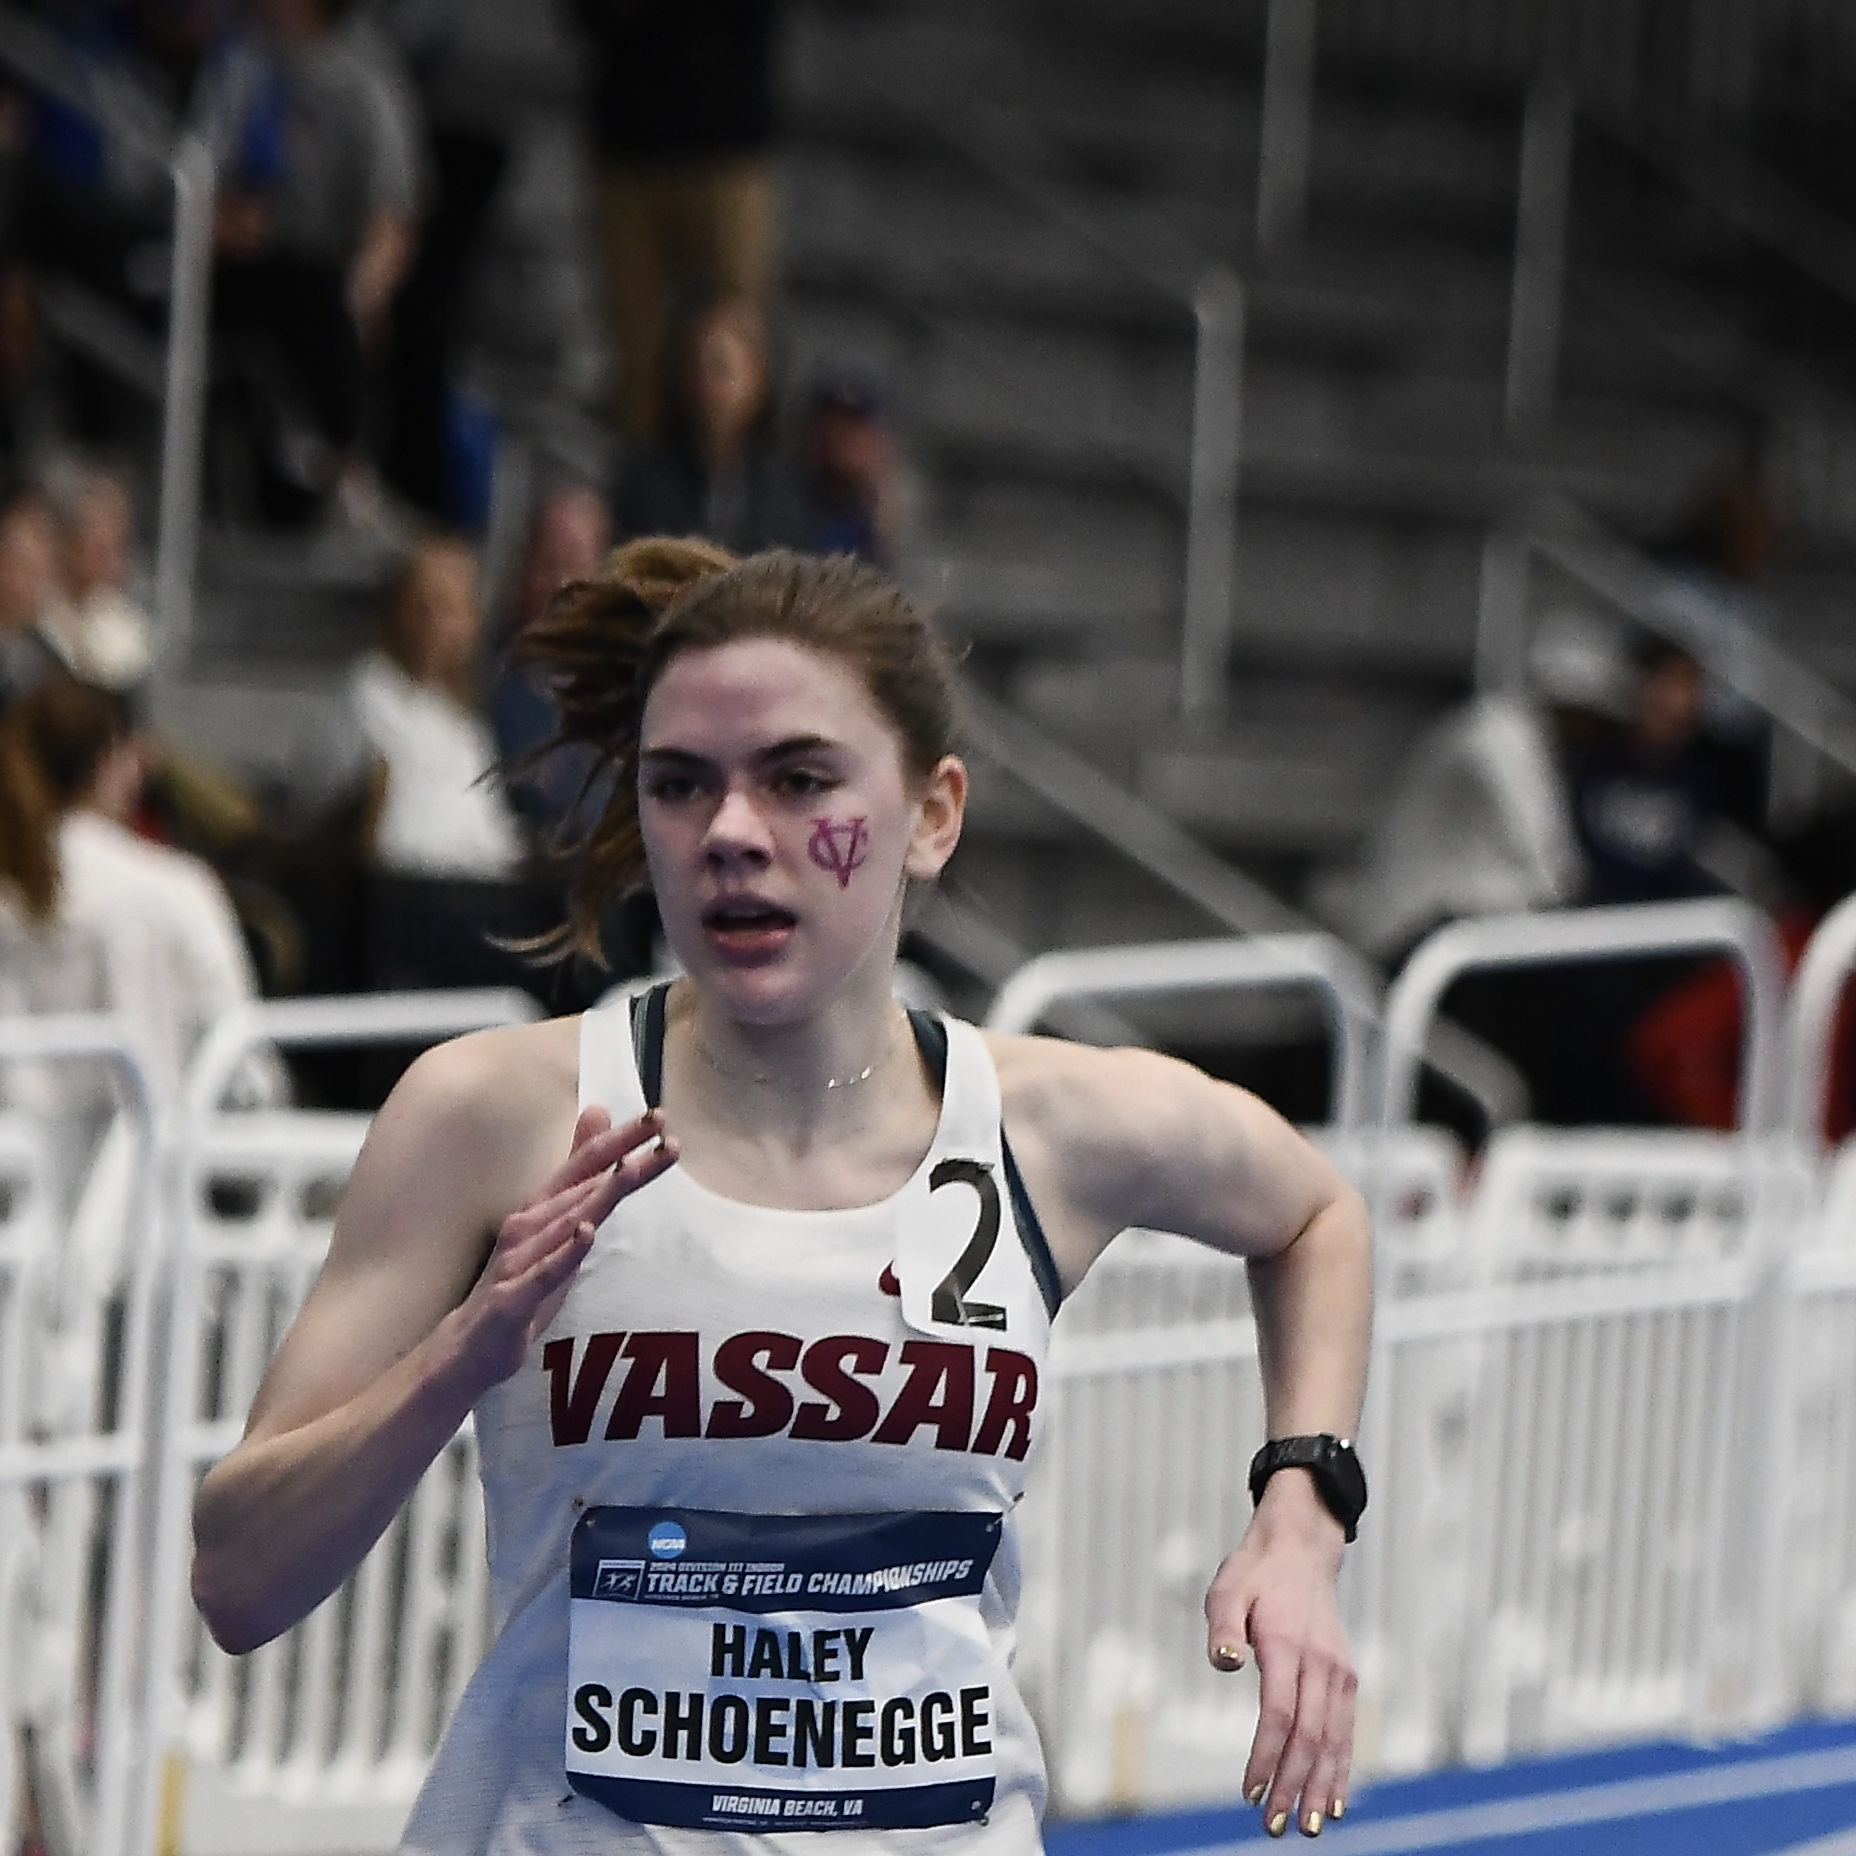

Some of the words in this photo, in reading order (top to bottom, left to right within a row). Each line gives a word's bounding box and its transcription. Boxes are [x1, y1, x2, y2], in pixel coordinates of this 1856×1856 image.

[929, 1156, 1007, 1332] 2
[543, 1329, 1039, 1463] VASSAR
[646, 1573, 720, 1594] TRACK
[721, 1574, 739, 1595] &
[740, 1573, 804, 1596] FIELD
[806, 1558, 975, 1596] CHAMPIONSHIPS
[678, 1562, 727, 1573] DIVISION
[728, 1562, 744, 1573] III
[710, 1623, 875, 1683] HALEY
[571, 1682, 994, 1769] SCHOENEGGE
[711, 1794, 781, 1817] VIRGINIA
[783, 1799, 838, 1817] BEACH,
[843, 1799, 863, 1816] VA
